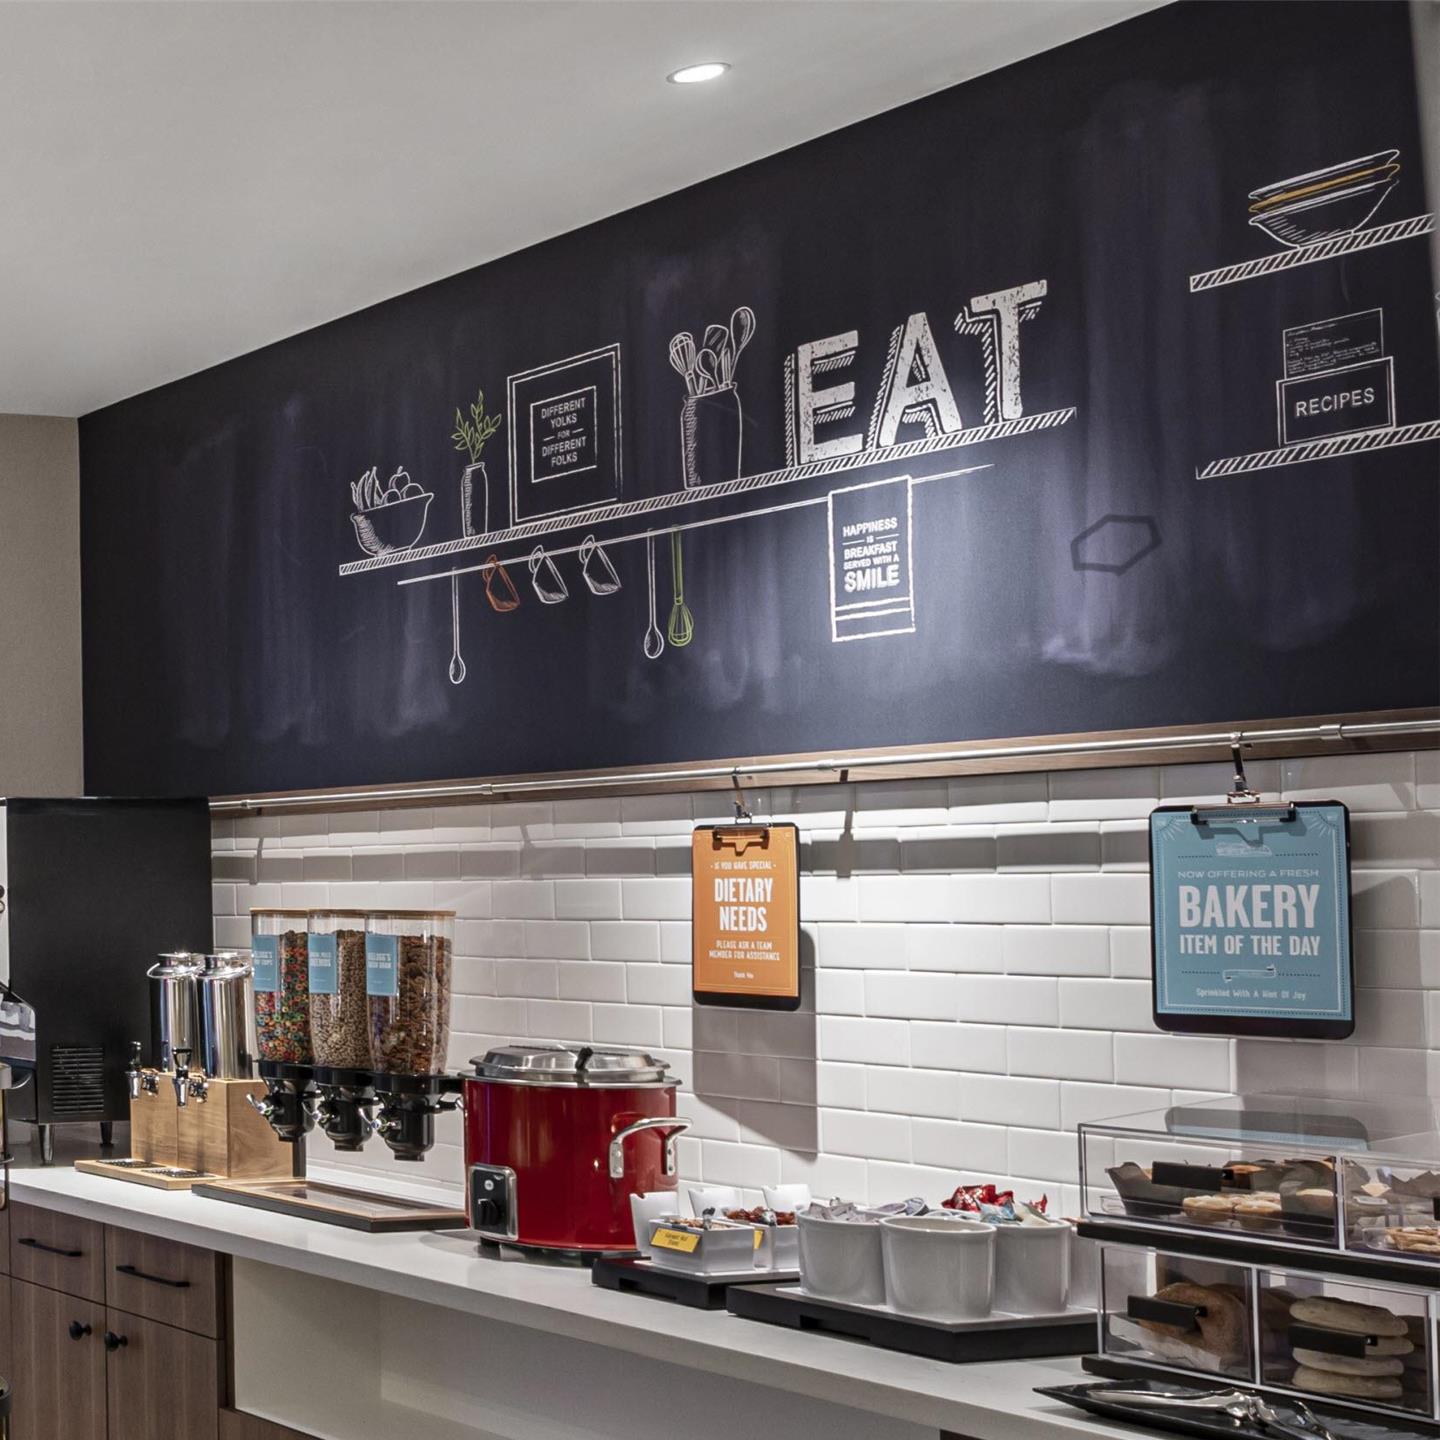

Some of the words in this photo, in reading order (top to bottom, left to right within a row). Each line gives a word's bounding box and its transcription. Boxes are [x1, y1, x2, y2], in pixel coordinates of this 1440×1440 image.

[784, 278, 1048, 468] EAT
[541, 397, 586, 419] DIFFERENT
[1295, 387, 1375, 418] RECIPES
[550, 413, 577, 429] YOLKS
[557, 429, 571, 440] FOR
[542, 436, 587, 457] DIFFERENT
[551, 451, 578, 467] FOLKS
[842, 516, 898, 538] HAPPINESS
[843, 540, 898, 560] BREAKFAST
[866, 535, 874, 543] IS
[843, 558, 871, 570] SERVED
[872, 554, 892, 565] WITH
[893, 553, 900, 562] A
[844, 564, 900, 593] SMILE
[1177, 871, 1205, 879] NOW
[1207, 870, 1266, 878] OFFERING
[1269, 870, 1277, 878] A
[1279, 869, 1320, 878] FRESH
[714, 877, 773, 903] DIETARY
[1178, 884, 1320, 928] BAKERY
[719, 905, 768, 932] NEEDS
[1179, 934, 1217, 954] ITEM
[1224, 934, 1245, 955] OF
[1249, 935, 1282, 956] THE
[1289, 935, 1321, 956] DAY
